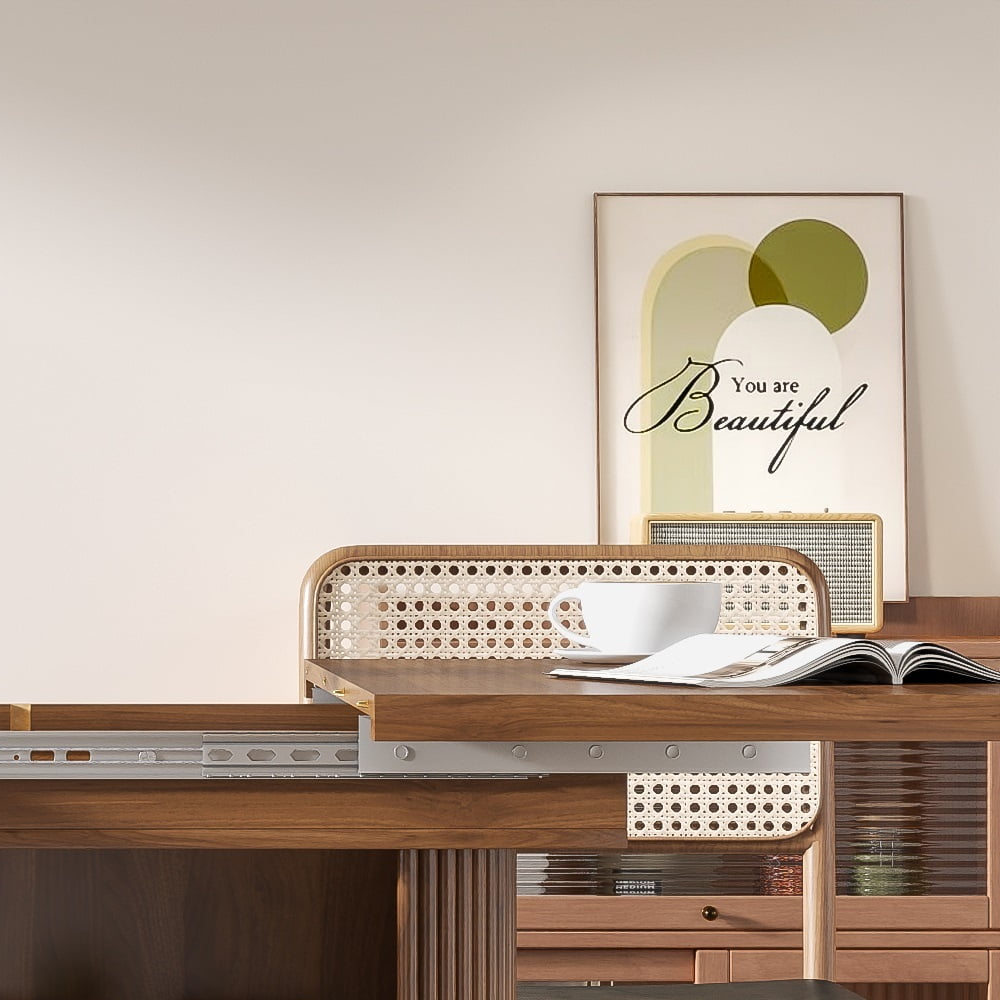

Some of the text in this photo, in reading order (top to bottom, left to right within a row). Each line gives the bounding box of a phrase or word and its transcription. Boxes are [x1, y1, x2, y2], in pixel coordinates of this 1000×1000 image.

[623, 357, 868, 474] Beautiful
[731, 377, 799, 393] You are
